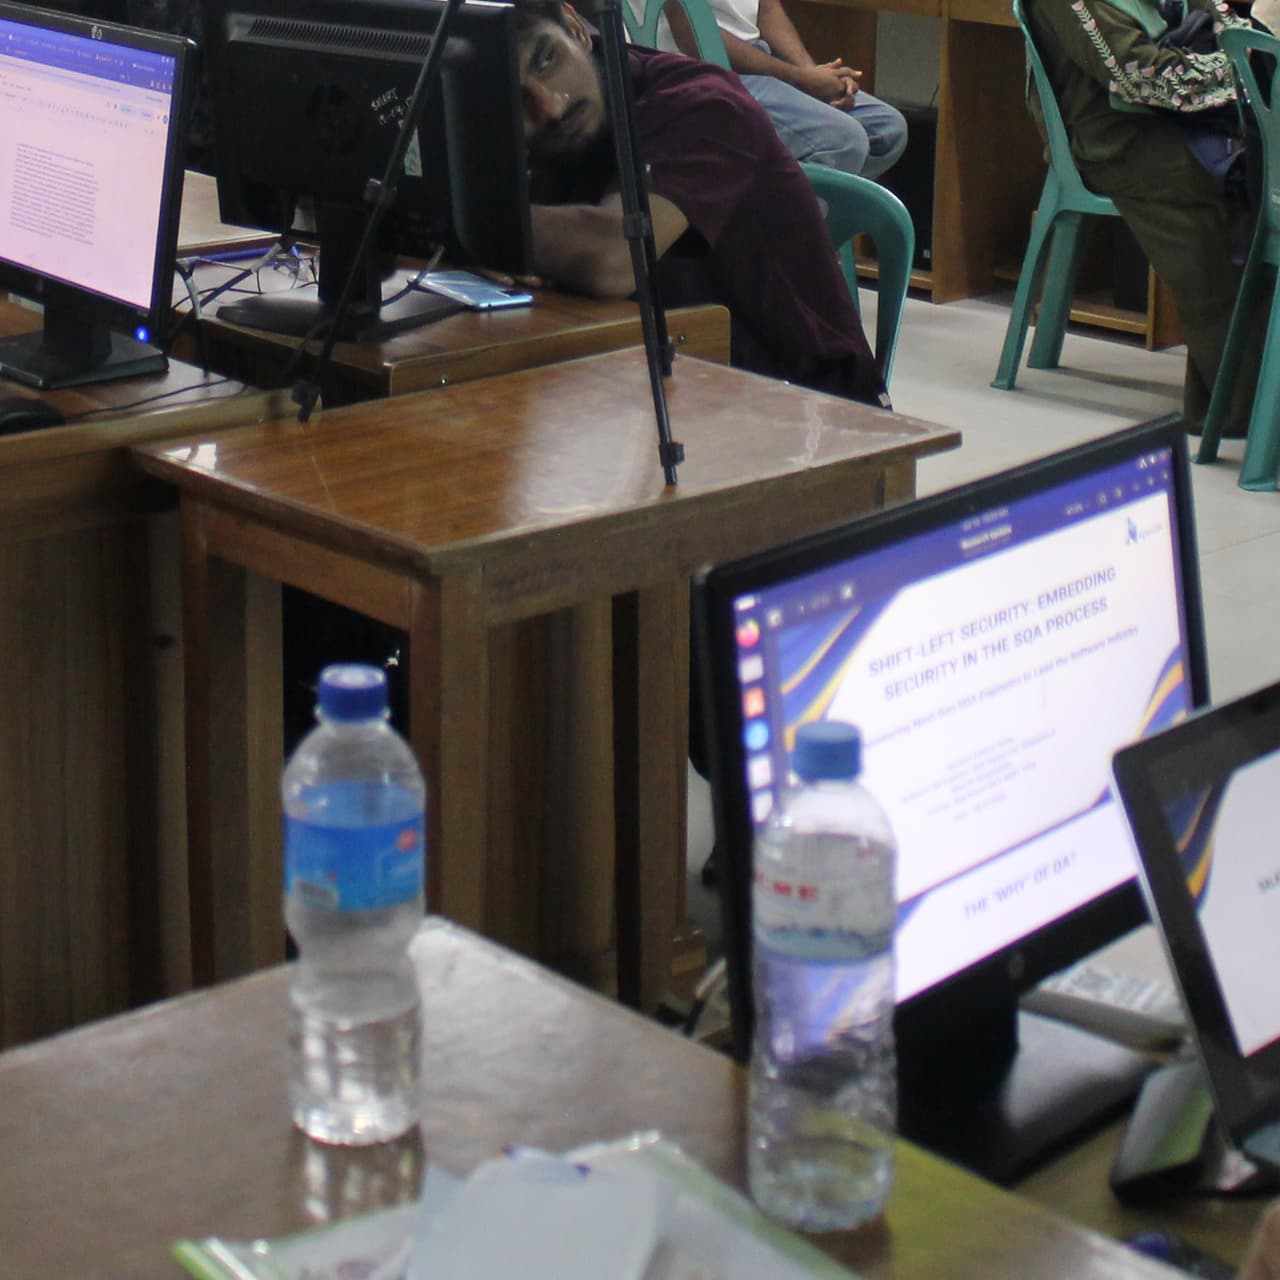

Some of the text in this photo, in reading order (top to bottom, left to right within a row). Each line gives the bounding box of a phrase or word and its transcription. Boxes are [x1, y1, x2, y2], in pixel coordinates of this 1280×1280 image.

[869, 631, 955, 677] SHIFT-LEFT
[1037, 567, 1116, 610] EMBEDDING
[885, 597, 1108, 700] SECURITY IN THE SQA PROCESS
